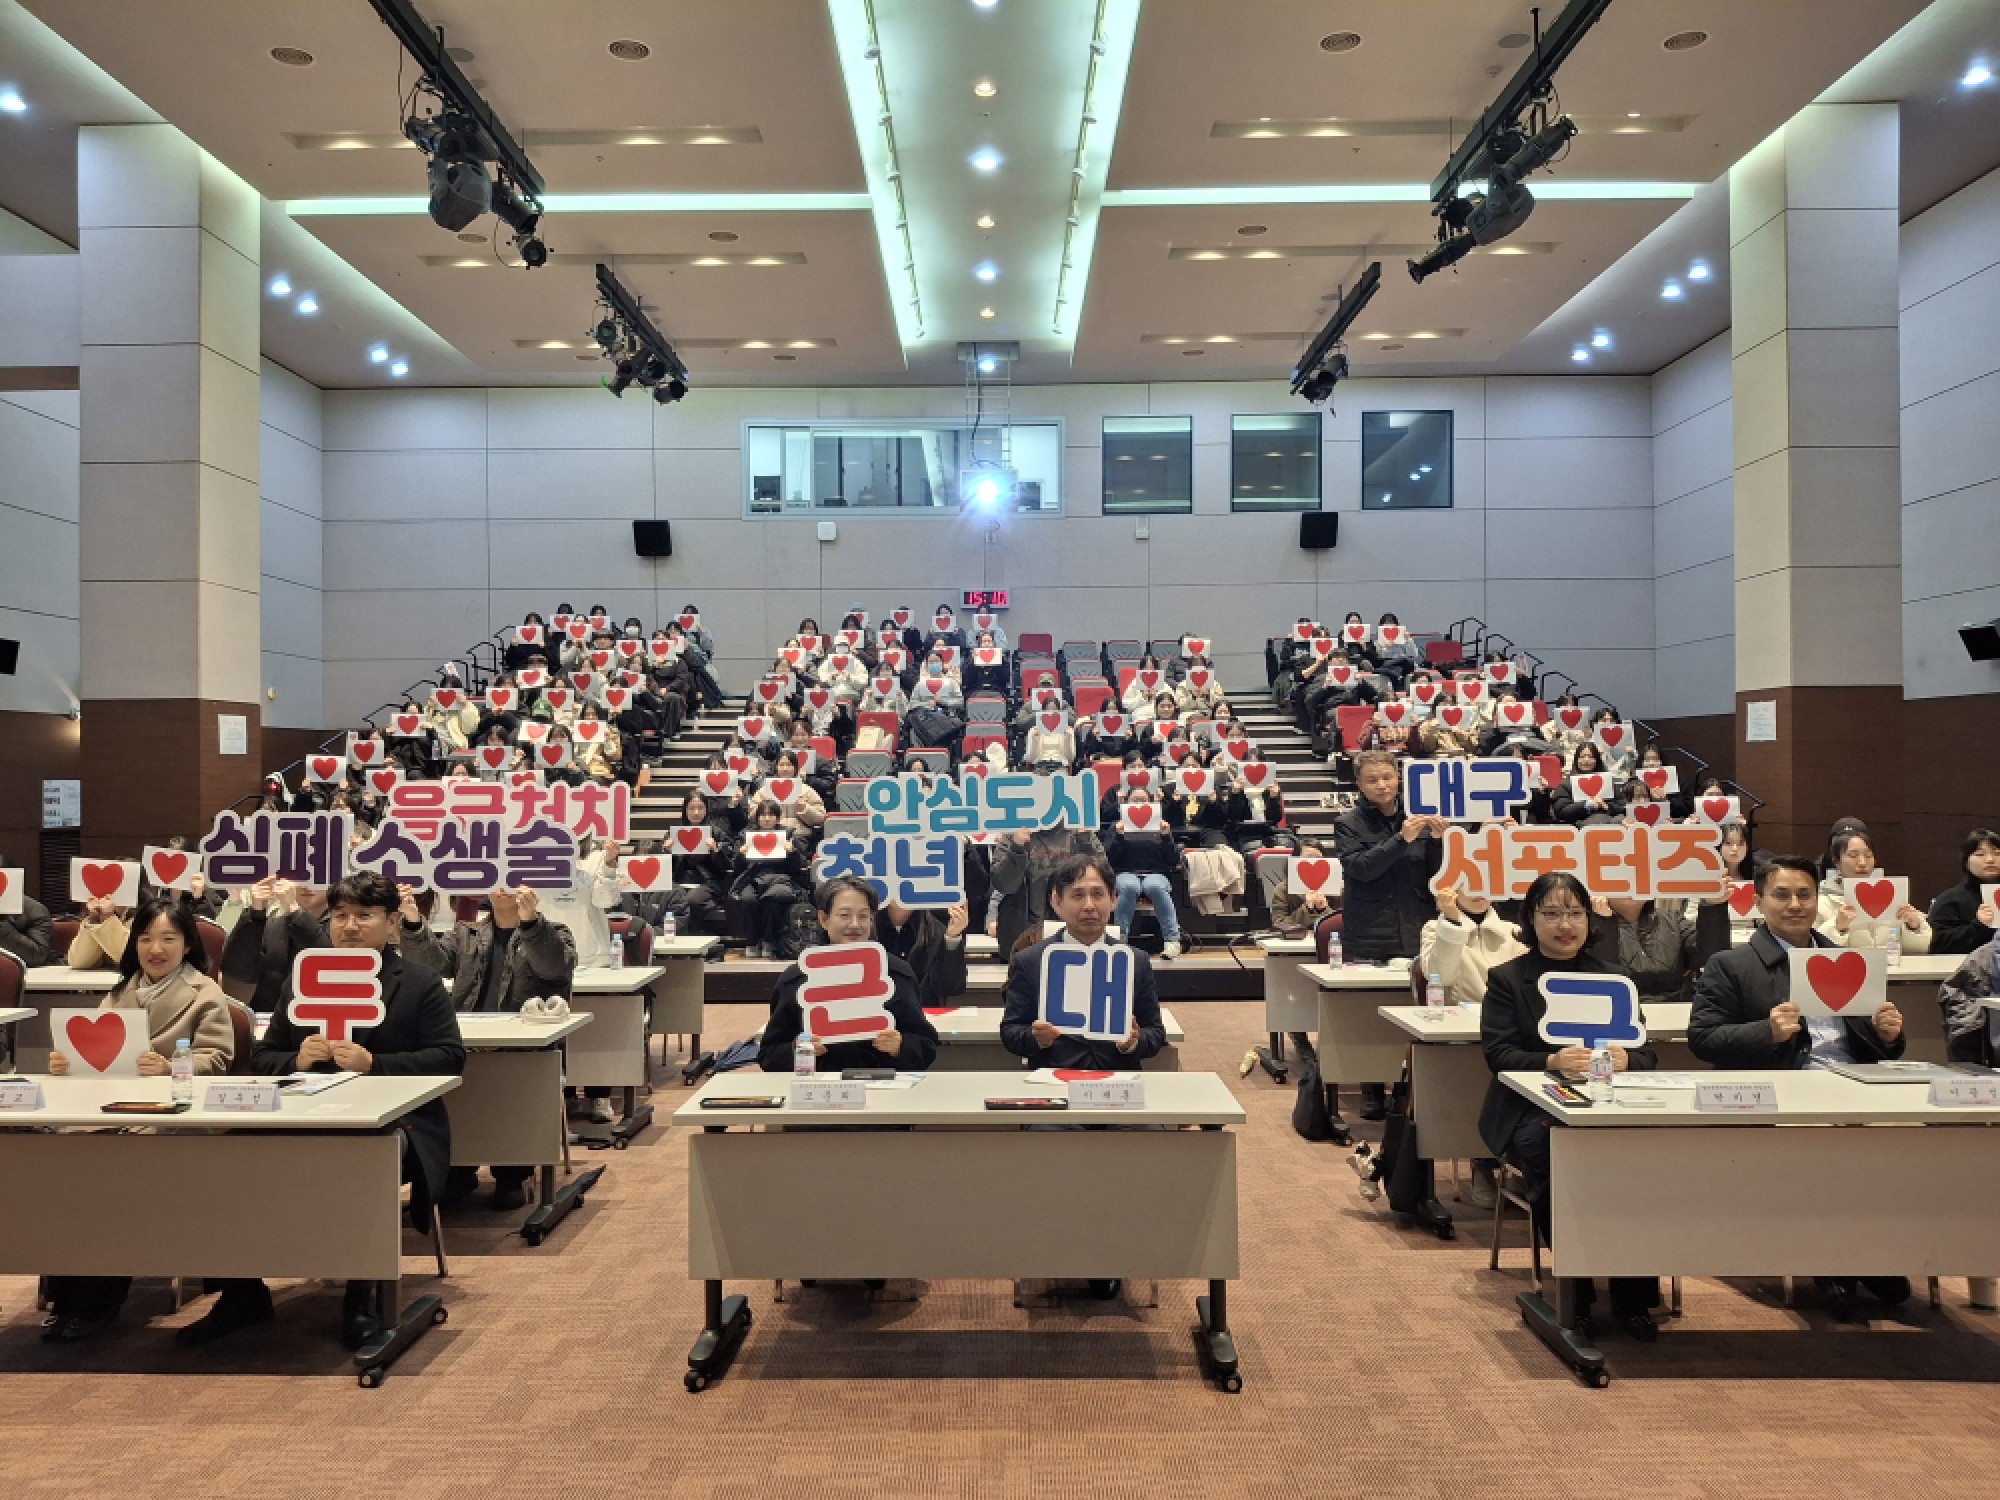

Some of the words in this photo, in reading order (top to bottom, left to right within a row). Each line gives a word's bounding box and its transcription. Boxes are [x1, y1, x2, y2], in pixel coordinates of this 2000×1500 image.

[868, 772, 1096, 833] 안심도시
[1408, 762, 1526, 817] 대구
[204, 815, 343, 885] 심폐
[356, 819, 575, 888] 소생술
[821, 835, 961, 903] 청년
[1436, 828, 1721, 895] 서포터즈
[294, 955, 379, 1041] 두
[803, 947, 889, 1037] 근
[1046, 949, 1129, 1035] 대
[1546, 978, 1640, 1050] 구
